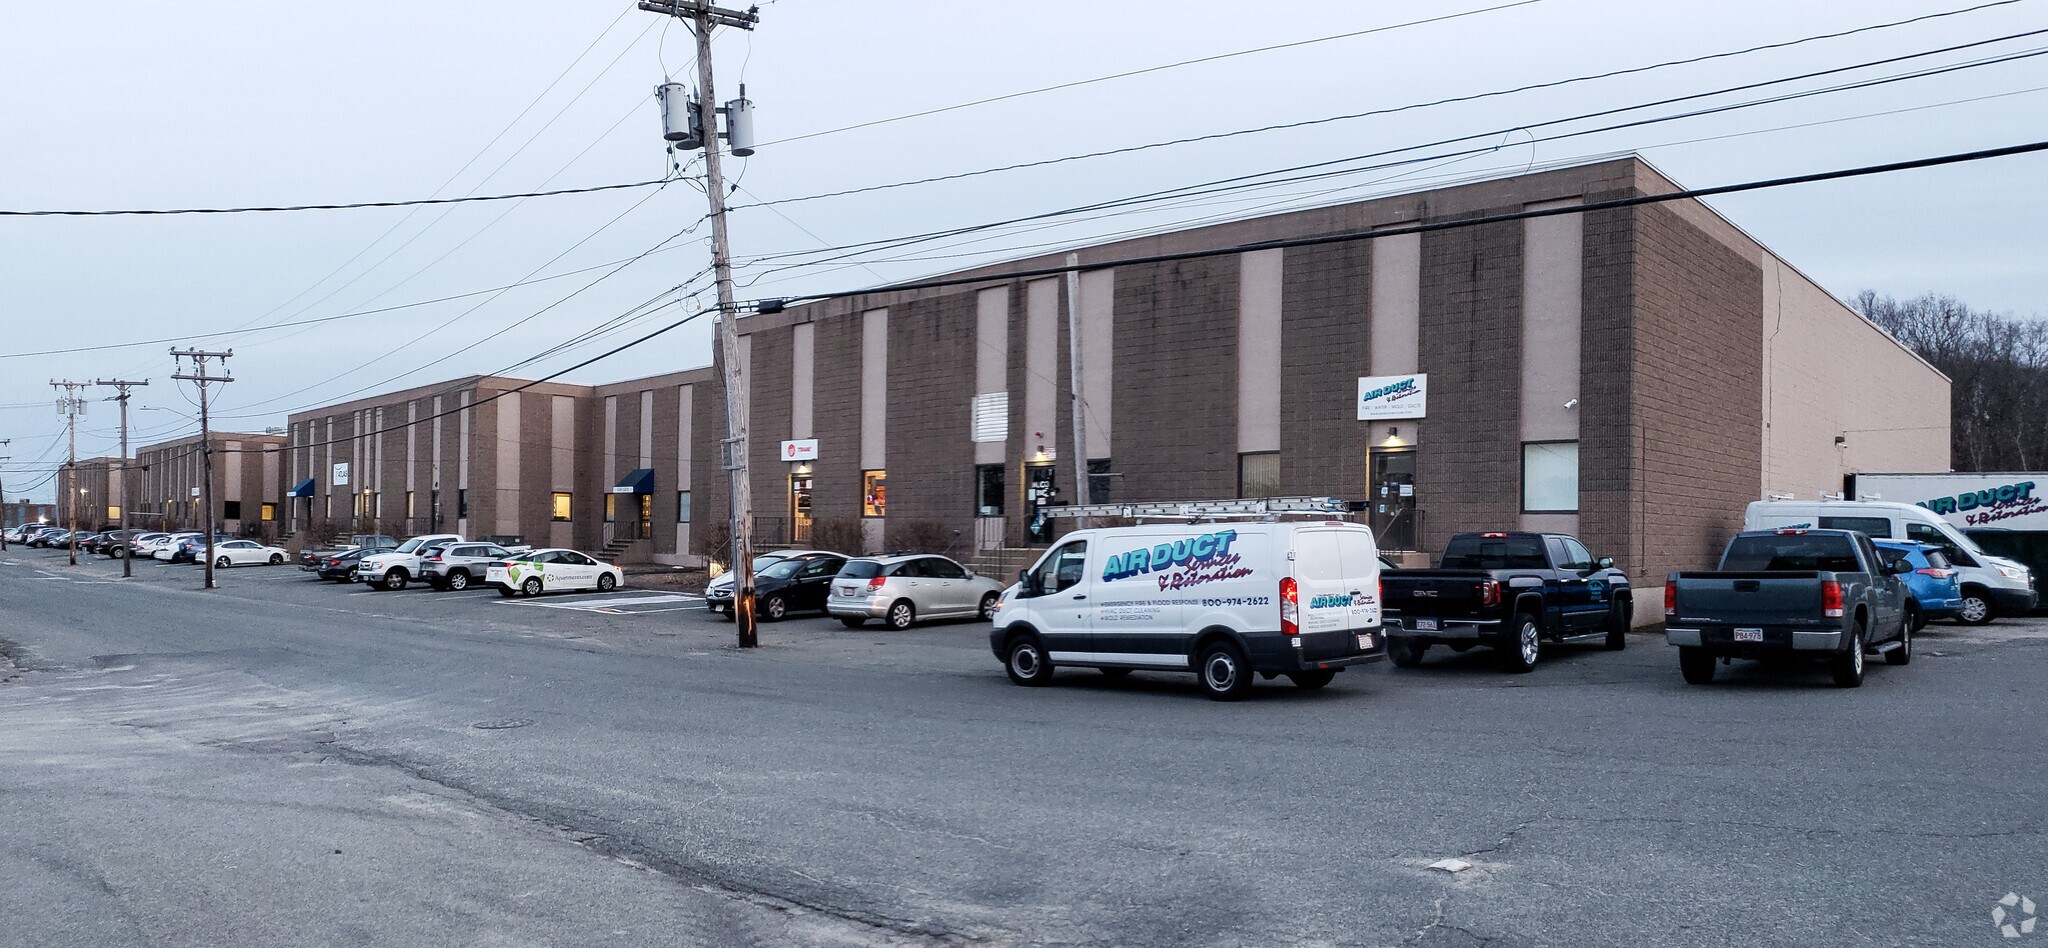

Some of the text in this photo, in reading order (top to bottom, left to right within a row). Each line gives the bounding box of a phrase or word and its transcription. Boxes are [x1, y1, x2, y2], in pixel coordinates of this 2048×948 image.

[1363, 378, 1414, 402] AIR DUCT
[1957, 481, 2036, 511] DUCT
[1990, 497, 2042, 513] Services
[1965, 514, 1978, 526] &
[1102, 529, 1238, 582] AIR DUCT
[1185, 553, 1242, 575] Services
[555, 574, 593, 582] Apartments.com
[1158, 567, 1254, 592] & Restoration
[1202, 597, 1269, 607] 800-974-2622
[1310, 595, 1353, 609] AIR DUCT
